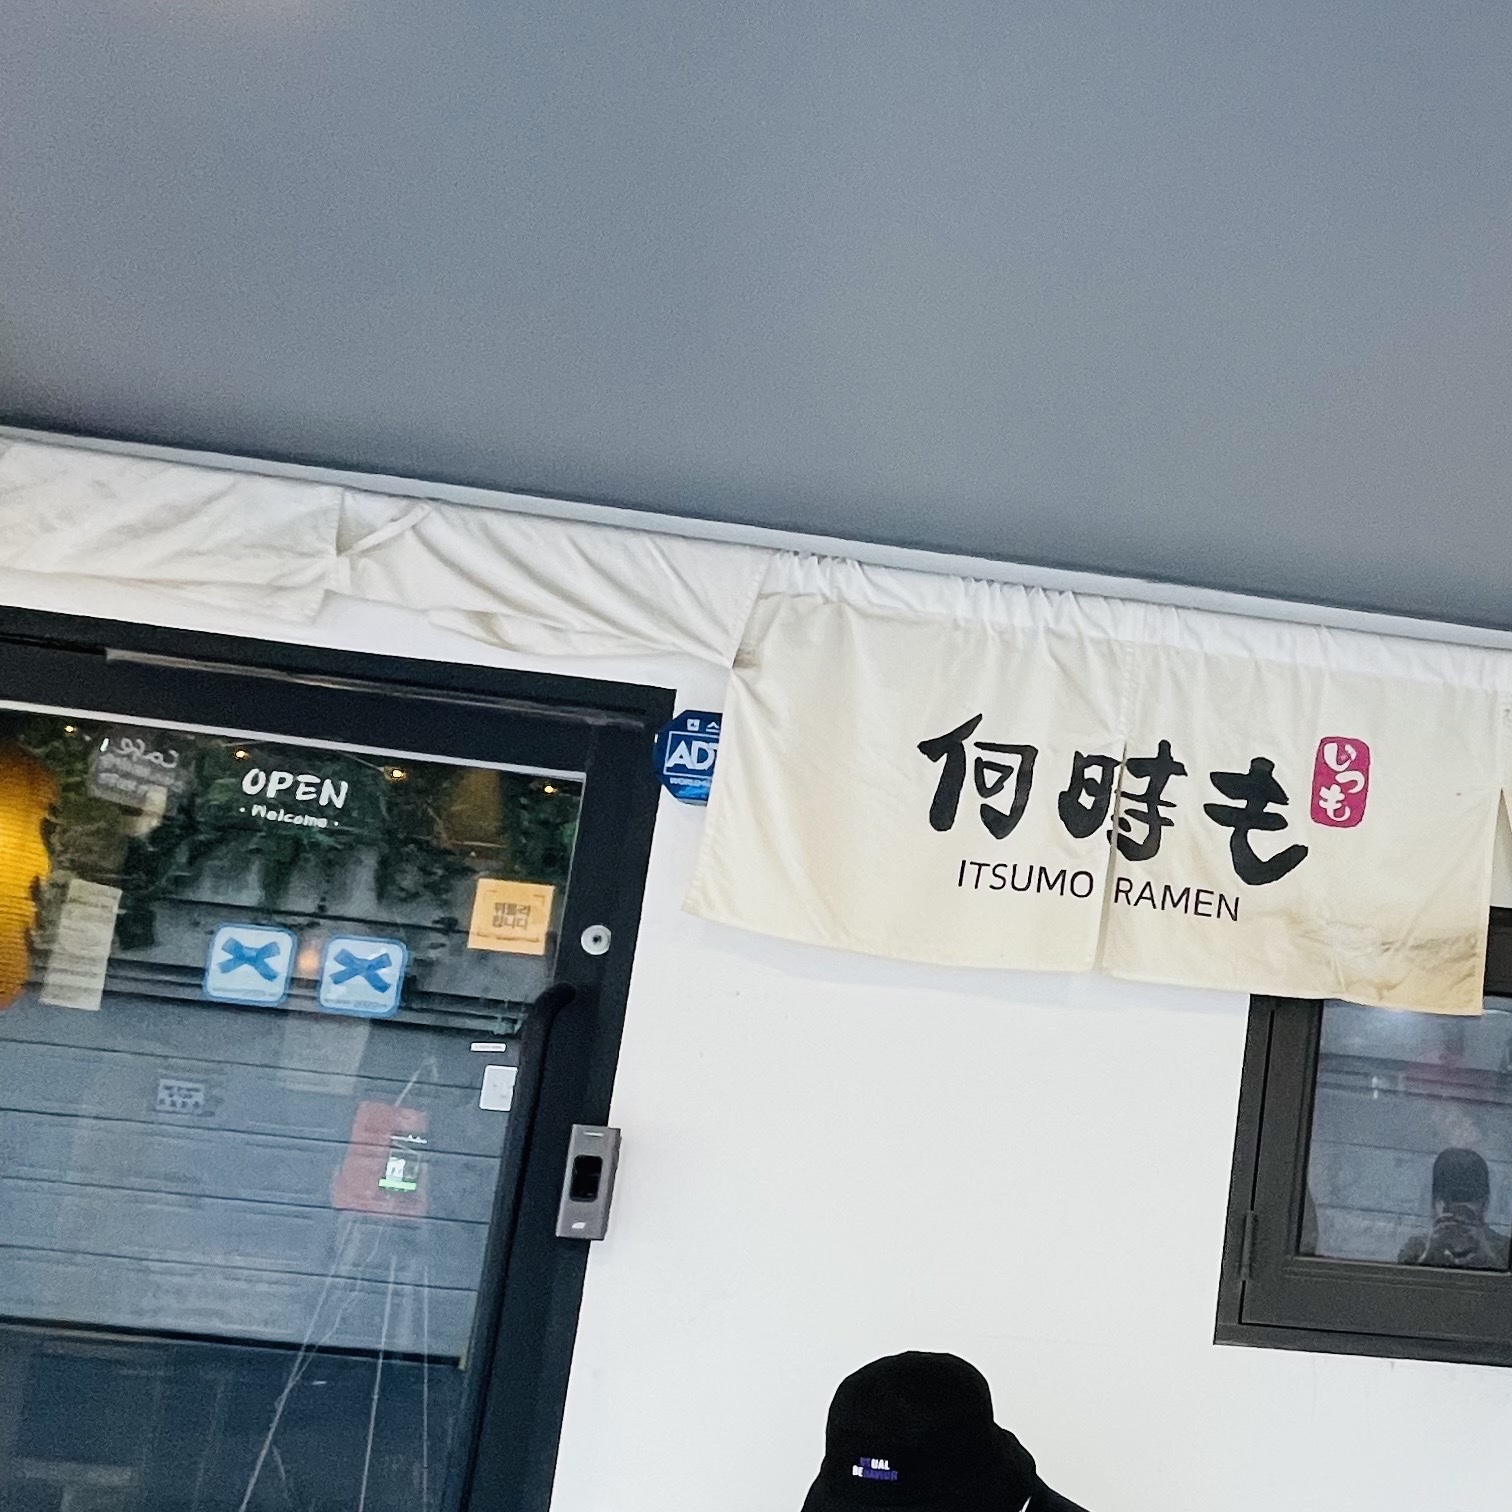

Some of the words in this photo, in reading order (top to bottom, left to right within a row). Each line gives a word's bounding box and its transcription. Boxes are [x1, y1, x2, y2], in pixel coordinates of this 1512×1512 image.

[241, 768, 349, 809] OPEN
[917, 712, 1309, 886] 何時も
[1318, 742, 1366, 822] いつも
[251, 804, 328, 828] Welcome
[957, 859, 1094, 899] ITSUMO
[1114, 877, 1240, 922] RAMEN
